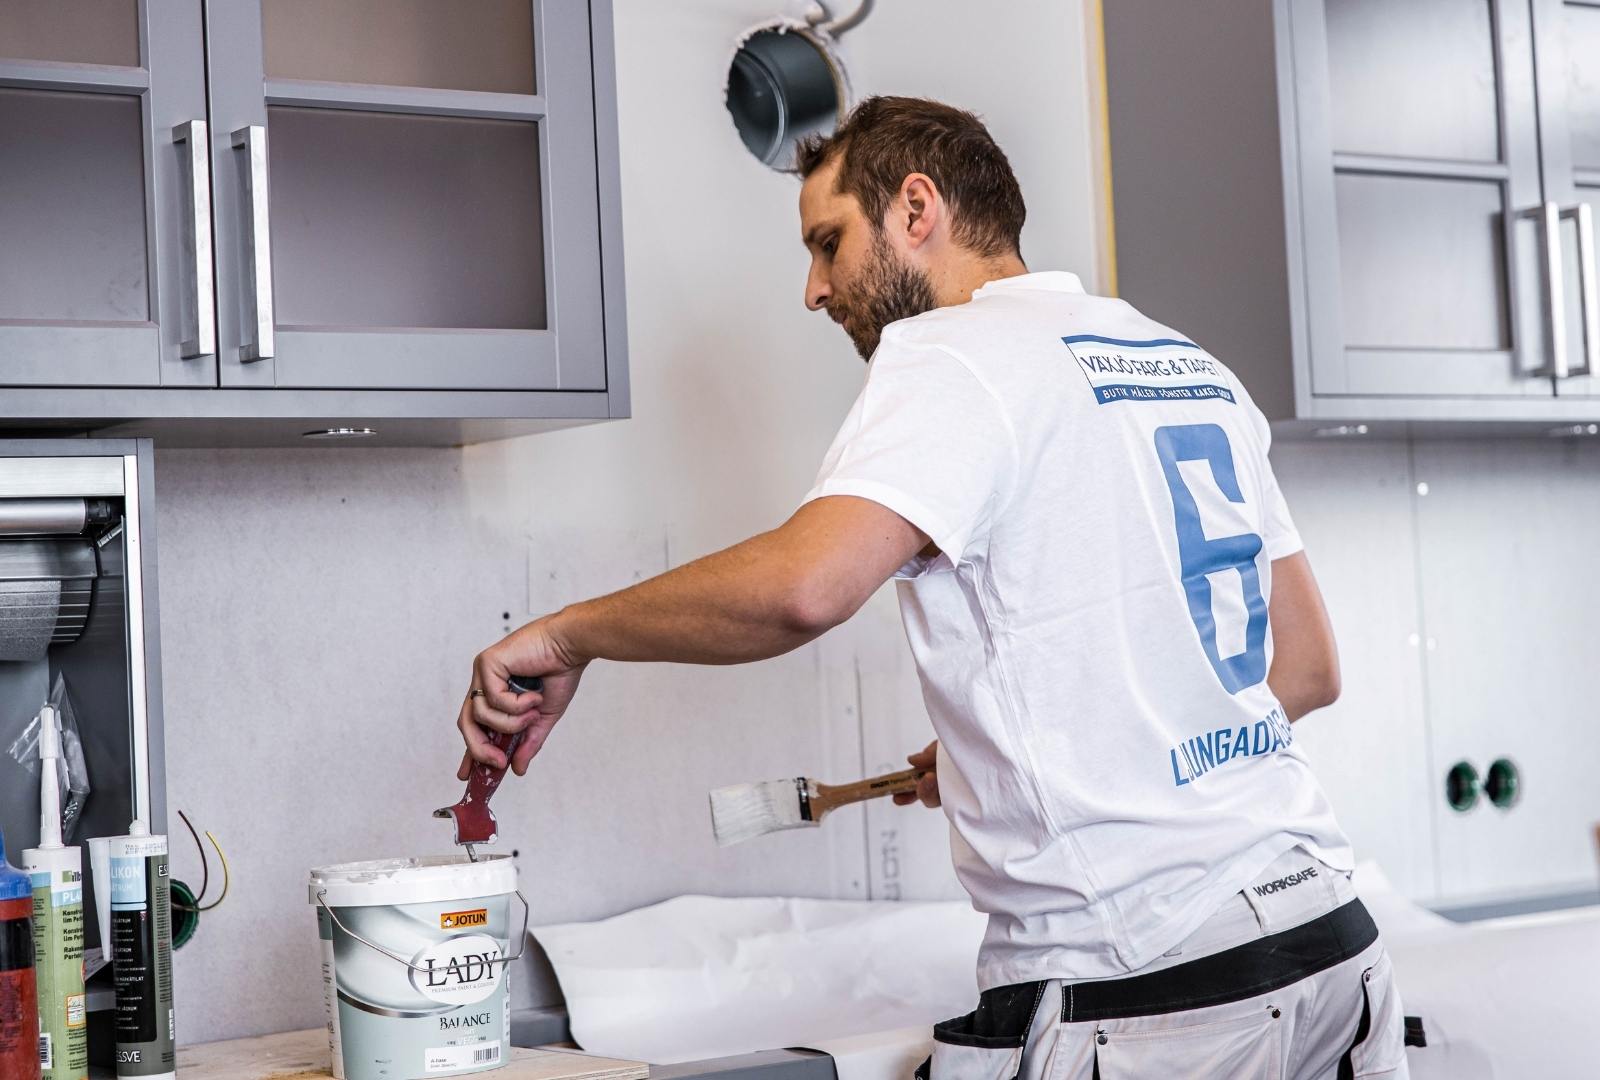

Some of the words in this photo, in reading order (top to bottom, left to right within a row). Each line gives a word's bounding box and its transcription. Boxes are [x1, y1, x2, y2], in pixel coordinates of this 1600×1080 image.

[1080, 354, 1134, 374] VÄXJÖ
[1171, 359, 1184, 375] &
[1102, 387, 1129, 399] BUTIK
[1154, 423, 1268, 696] 6
[111, 865, 141, 879] LIKON
[1253, 866, 1318, 897] WORKSAFE
[454, 912, 487, 926] JOTUN
[425, 950, 498, 987] LADY
[440, 1012, 491, 1031] BALANCE
[116, 1050, 141, 1063] SSVE
